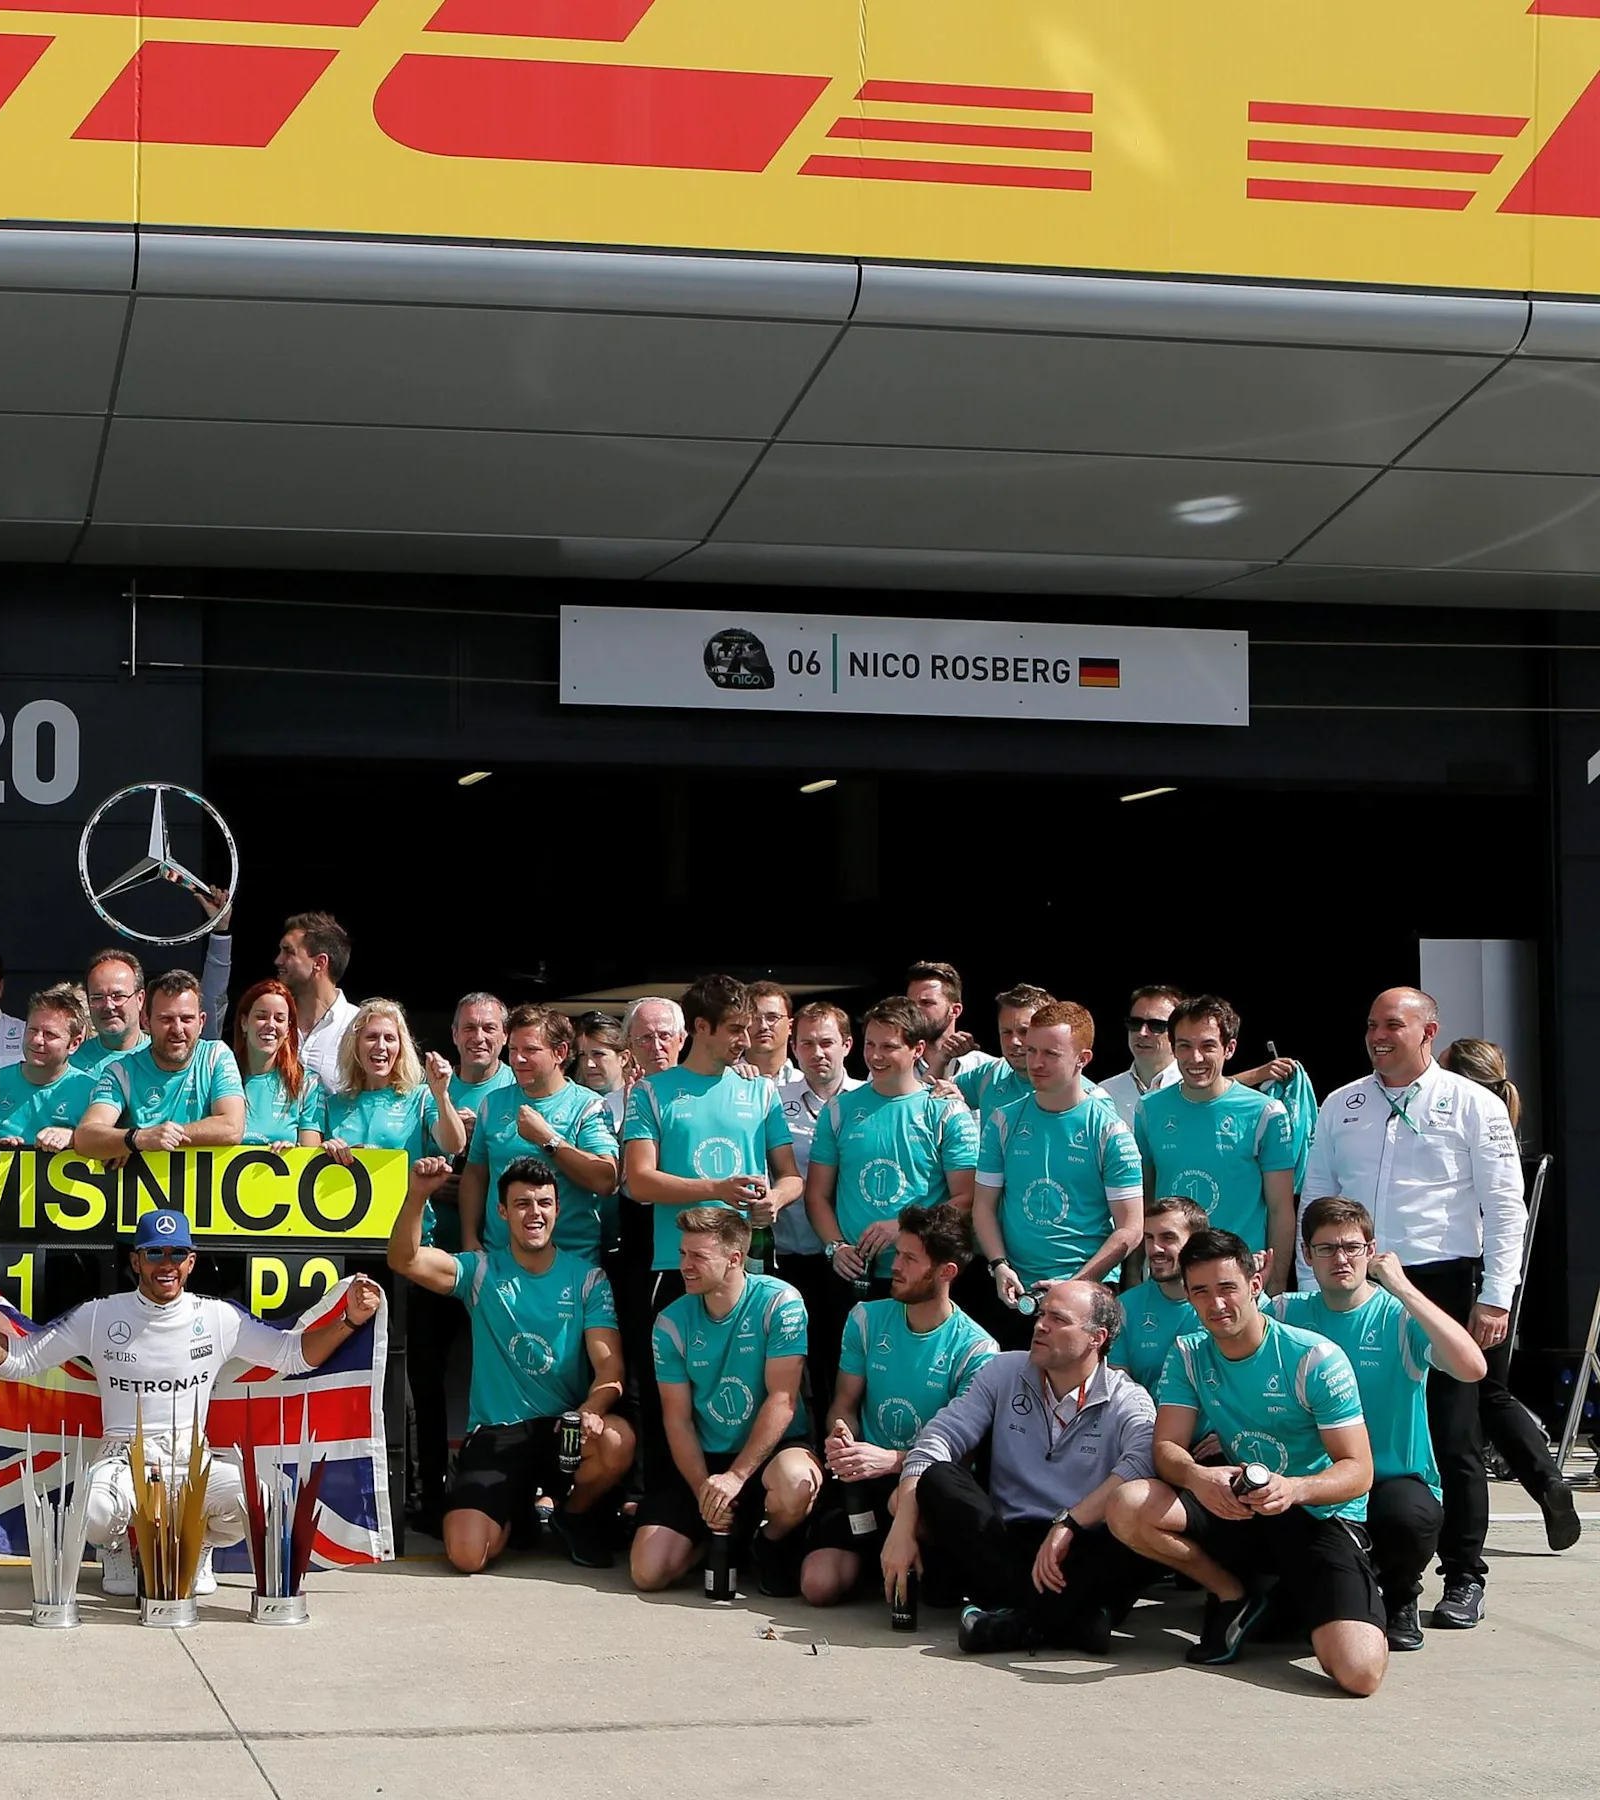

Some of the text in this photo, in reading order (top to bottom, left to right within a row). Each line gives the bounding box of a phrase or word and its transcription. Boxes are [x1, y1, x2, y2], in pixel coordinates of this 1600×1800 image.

[787, 649, 1071, 684] 06 NICO ROSBERG
[710, 1146, 723, 1174] 1
[122, 1150, 372, 1232] NICO
[874, 1168, 887, 1196] 1
[116, 1352, 137, 1362] UBS
[191, 1345, 212, 1358] BOSS
[109, 1371, 209, 1393] PETRONAS
[720, 1386, 736, 1415] 1
[891, 1408, 904, 1437] 1
[1242, 1430, 1277, 1444] WINNERS
